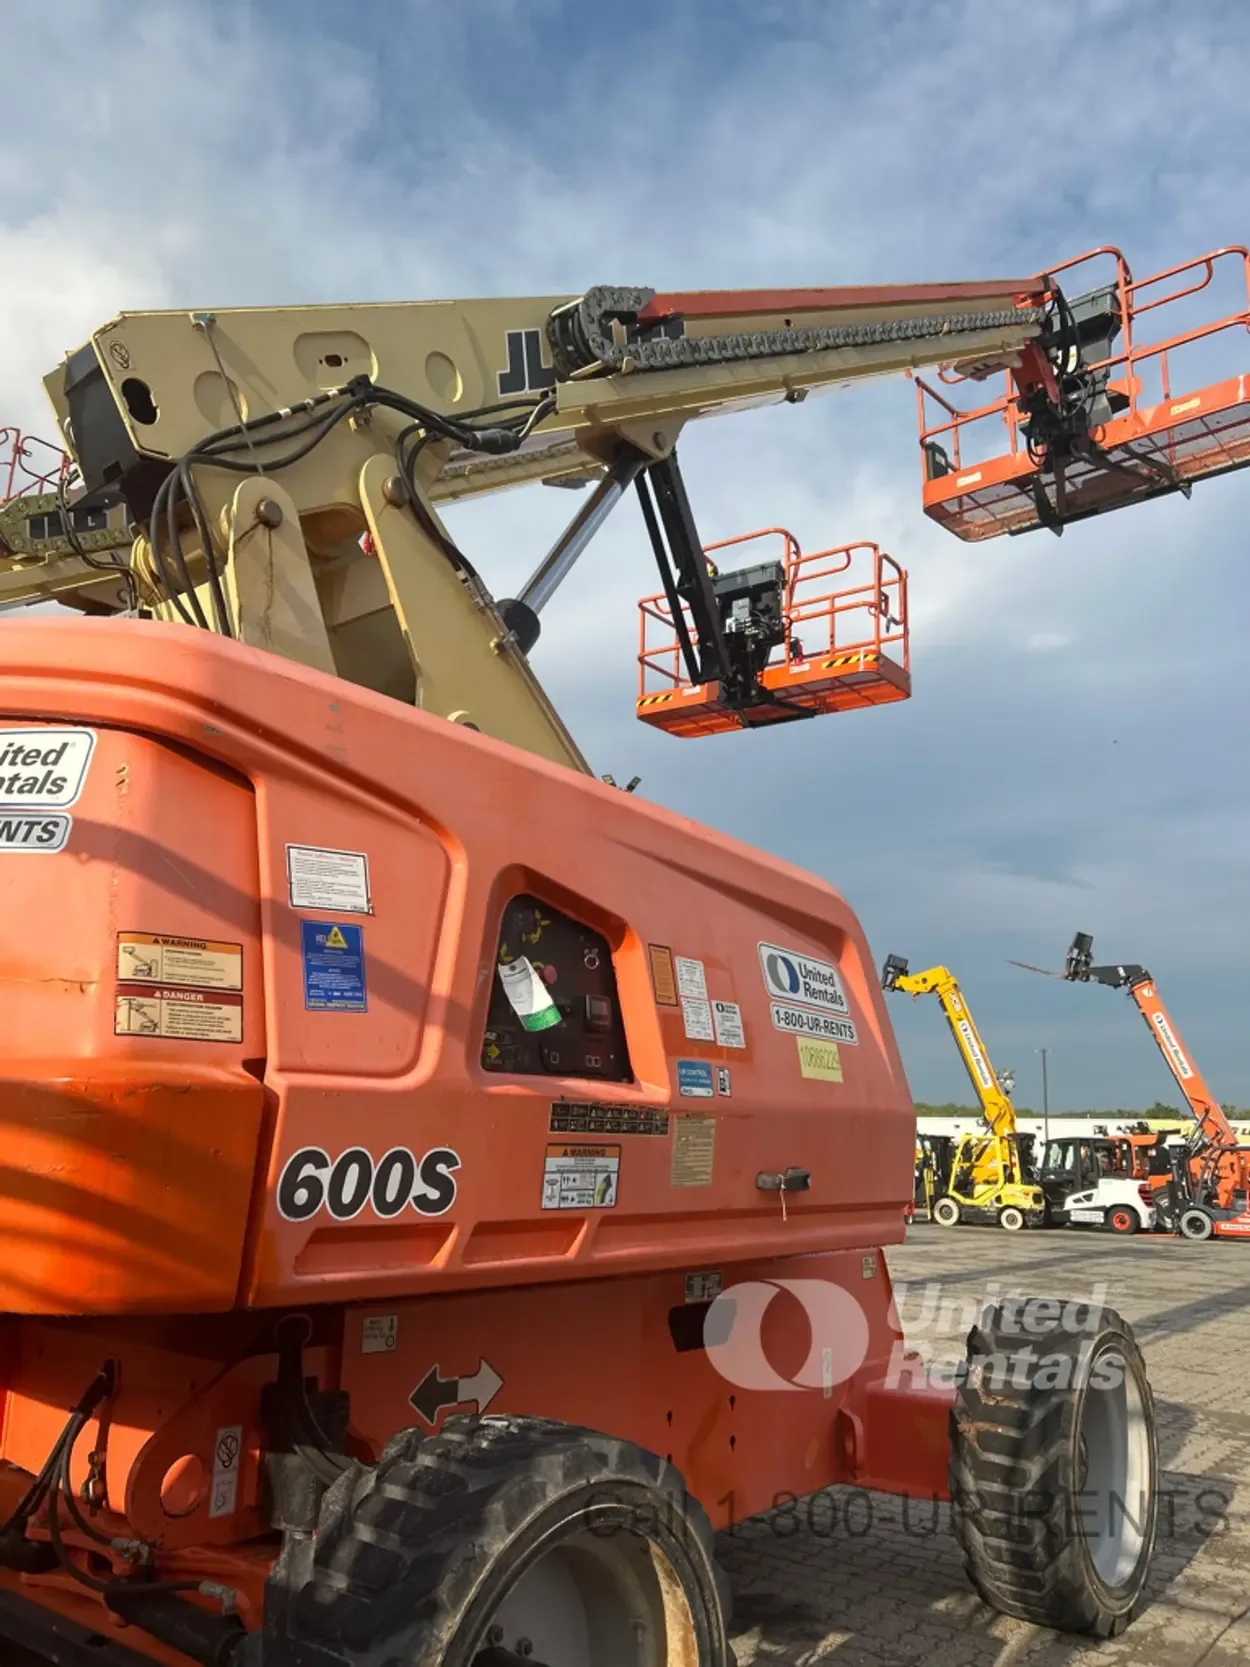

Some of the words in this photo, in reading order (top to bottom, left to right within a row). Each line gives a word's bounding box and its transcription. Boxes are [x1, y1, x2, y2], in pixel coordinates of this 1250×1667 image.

[161, 938, 207, 950] WARNING
[798, 962, 836, 988] United
[163, 991, 204, 1001] DANGER
[803, 981, 844, 1006] Rentals
[775, 1009, 854, 1039] 1-800-UR-RENTS
[569, 1148, 606, 1157] WARNING
[277, 1146, 461, 1221] 600S
